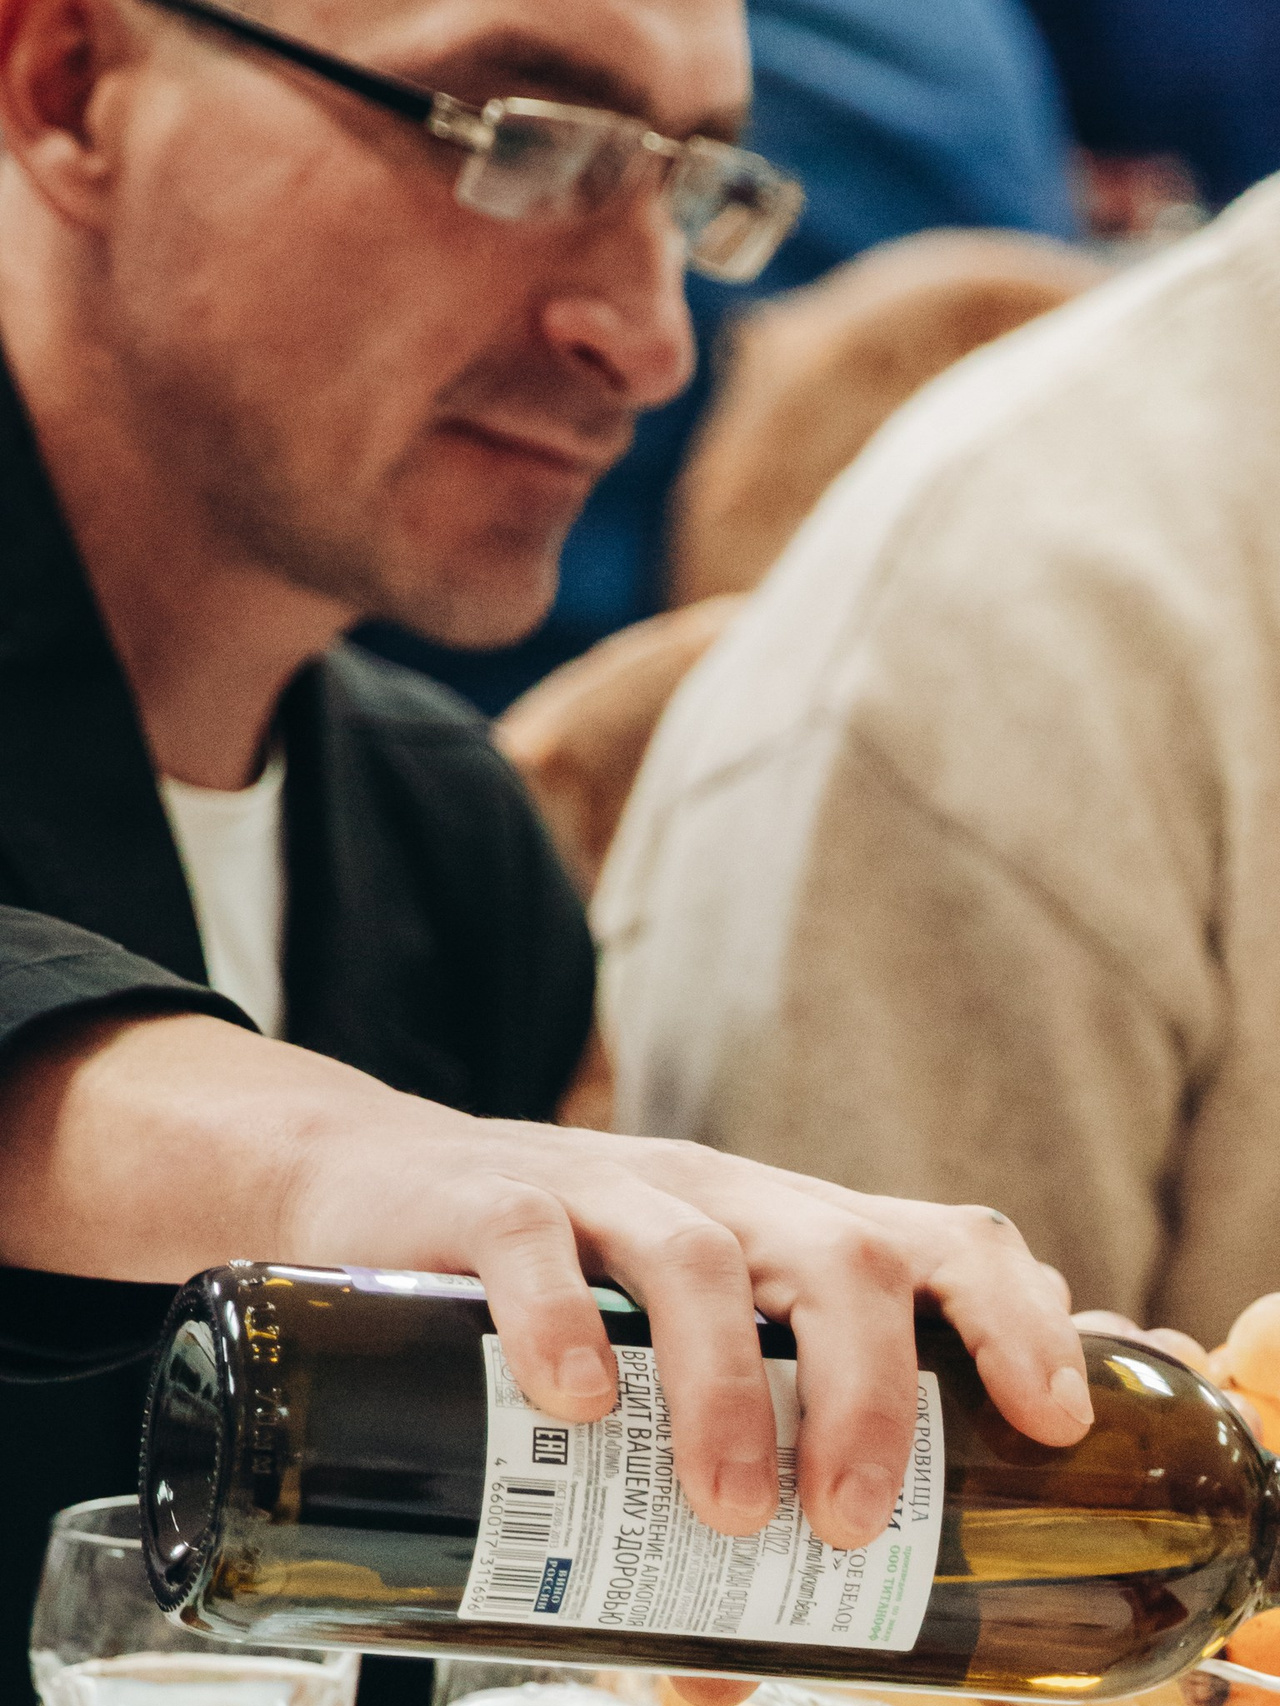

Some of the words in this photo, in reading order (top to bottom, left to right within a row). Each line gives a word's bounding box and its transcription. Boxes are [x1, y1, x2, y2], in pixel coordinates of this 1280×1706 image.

[620, 1350, 652, 1423] ВРЕДИТ
[494, 1456, 508, 1467] 4
[622, 1427, 652, 1521] ВАШЕМУ
[483, 1481, 505, 1549] 660017
[644, 1445, 674, 1562] УПОТРЕБЛЕНИЕ
[466, 1556, 496, 1614] 311696
[536, 1559, 558, 1611] РОССИИ
[550, 1569, 569, 1606] ВИНО
[597, 1524, 646, 1627] ЗДОРОВЬЮ
[625, 1564, 661, 1628] АЛКОГОЛЯ
[831, 1582, 862, 1633] БЕЛОЕ
